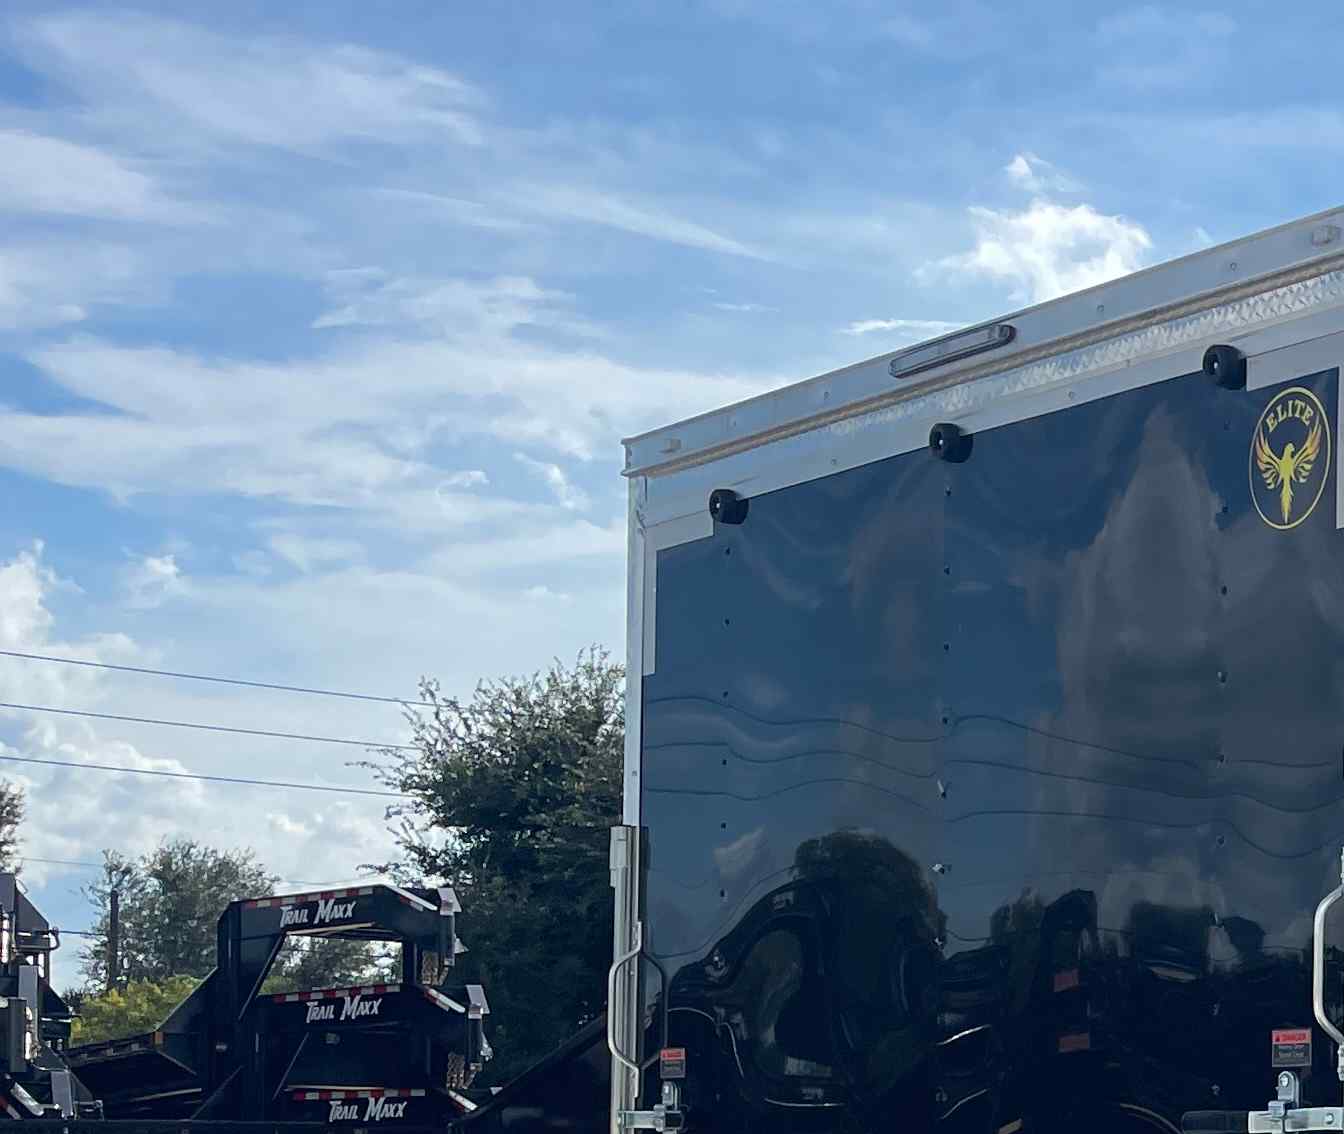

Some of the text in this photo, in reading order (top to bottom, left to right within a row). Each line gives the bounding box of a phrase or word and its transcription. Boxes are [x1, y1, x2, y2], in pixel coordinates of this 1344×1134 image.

[1266, 399, 1315, 433] ELITE
[279, 898, 357, 929] TRAIL MAXX
[306, 994, 383, 1024] TRAIL MAXX
[329, 1096, 408, 1123] TRAIL MAXX
